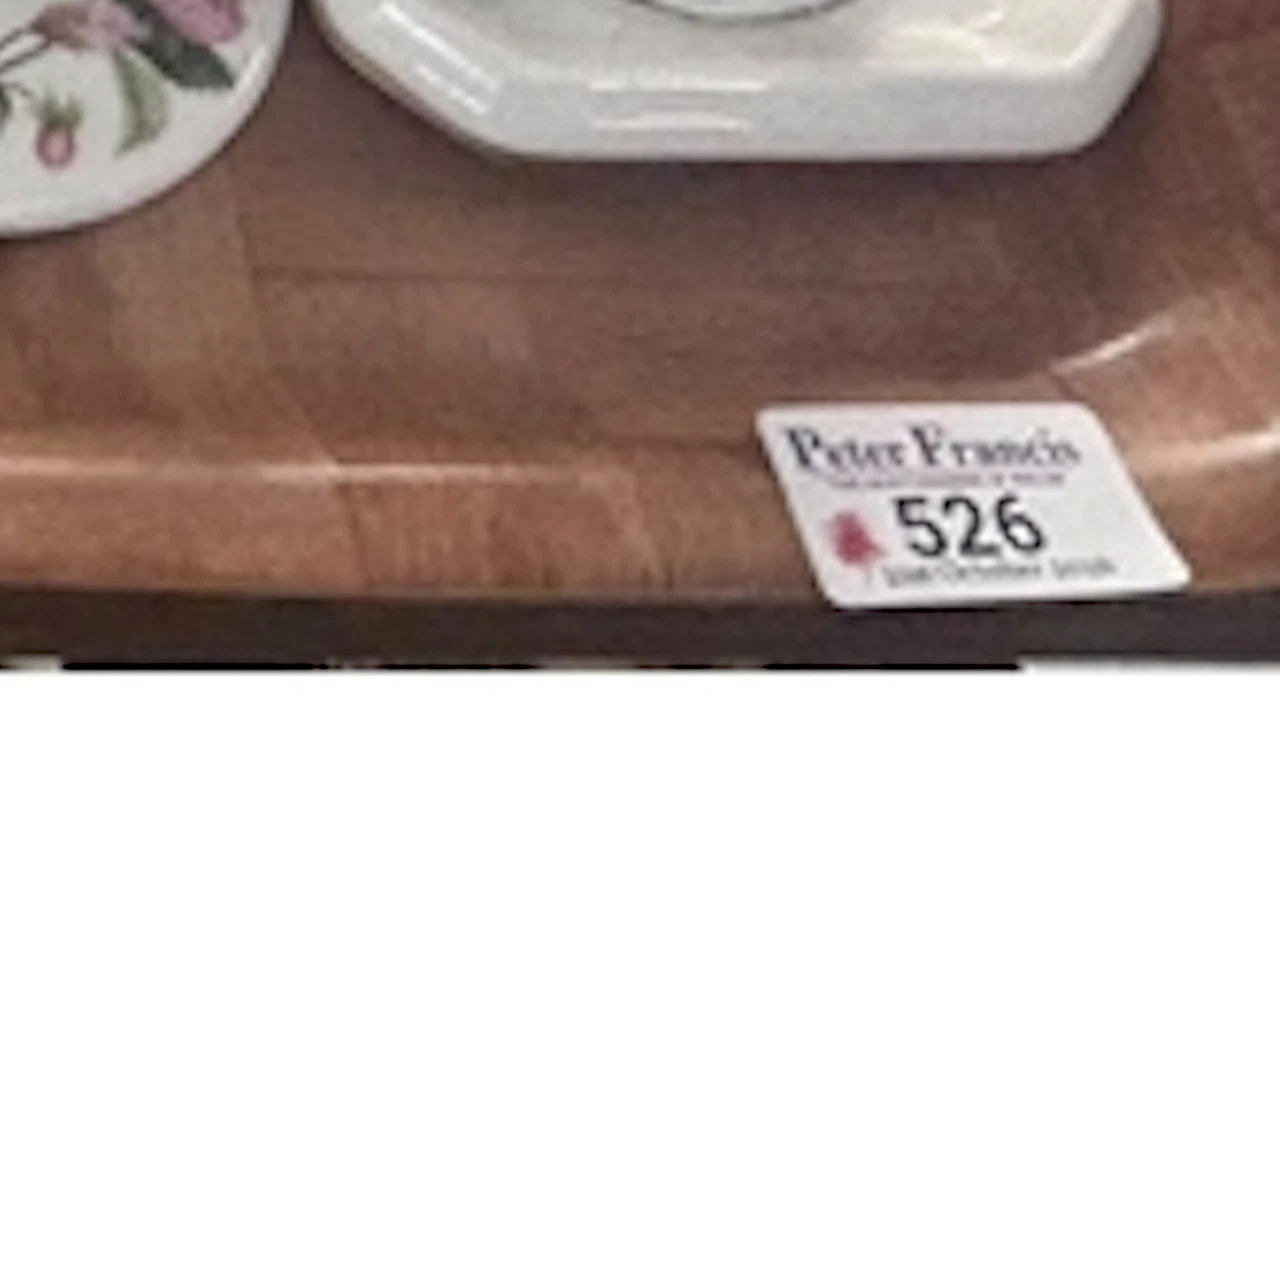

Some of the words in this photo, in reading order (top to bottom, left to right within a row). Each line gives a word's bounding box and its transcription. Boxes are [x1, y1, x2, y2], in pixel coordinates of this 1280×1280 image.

[784, 426, 904, 470] Peter
[907, 422, 1082, 468] Francis
[894, 493, 1049, 558] 526
